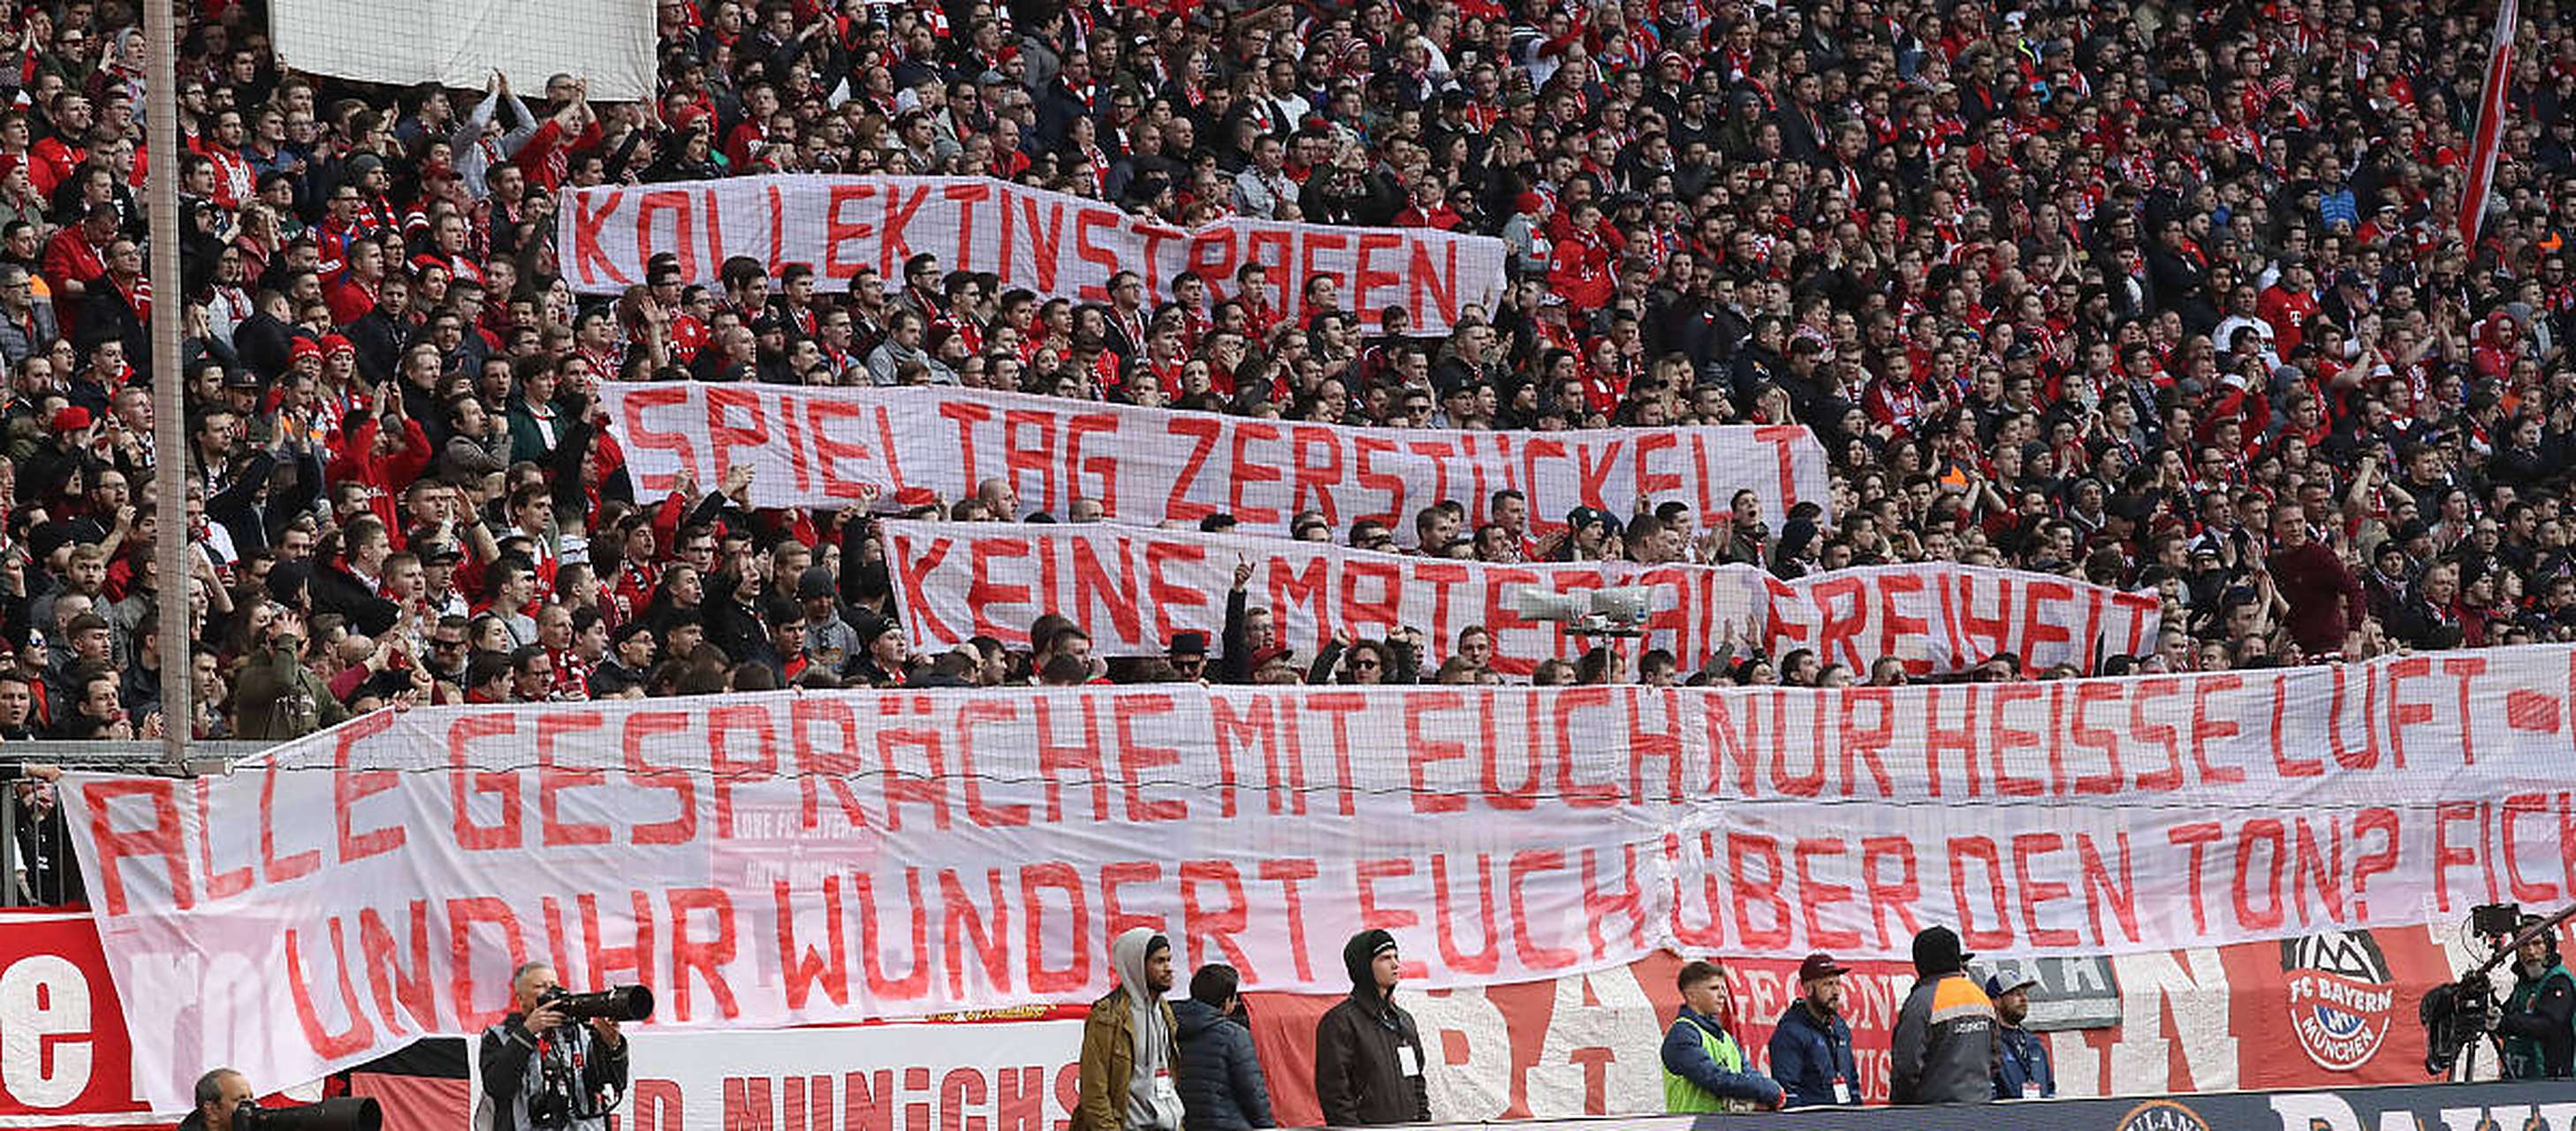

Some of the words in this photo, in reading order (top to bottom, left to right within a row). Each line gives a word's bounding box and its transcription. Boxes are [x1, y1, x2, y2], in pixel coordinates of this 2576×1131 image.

[574, 184, 1457, 330] KOLLEKTIVSTRAFEN
[1166, 418, 1808, 530] ZERSTÜCKELT
[895, 535, 1212, 647] KEINE
[83, 710, 406, 915] ALLE
[448, 695, 1188, 850] GESPRÄCHE
[1211, 691, 1366, 817] MIT
[1405, 687, 1683, 813] EUCH
[1705, 688, 1895, 798] NUR
[1925, 674, 2246, 798] HEISSE
[2269, 657, 2487, 777] LUFT
[285, 893, 527, 1061] UND
[542, 887, 741, 1025] IHR
[775, 858, 1318, 1010] WUNDERT
[1356, 842, 1647, 980] EUCH
[1664, 831, 1924, 951] ÜBER
[1948, 832, 2142, 951] DEN
[2168, 808, 2399, 936] TON?
[2290, 975, 2314, 1003] FC
[2317, 977, 2393, 1013] BAYERN
